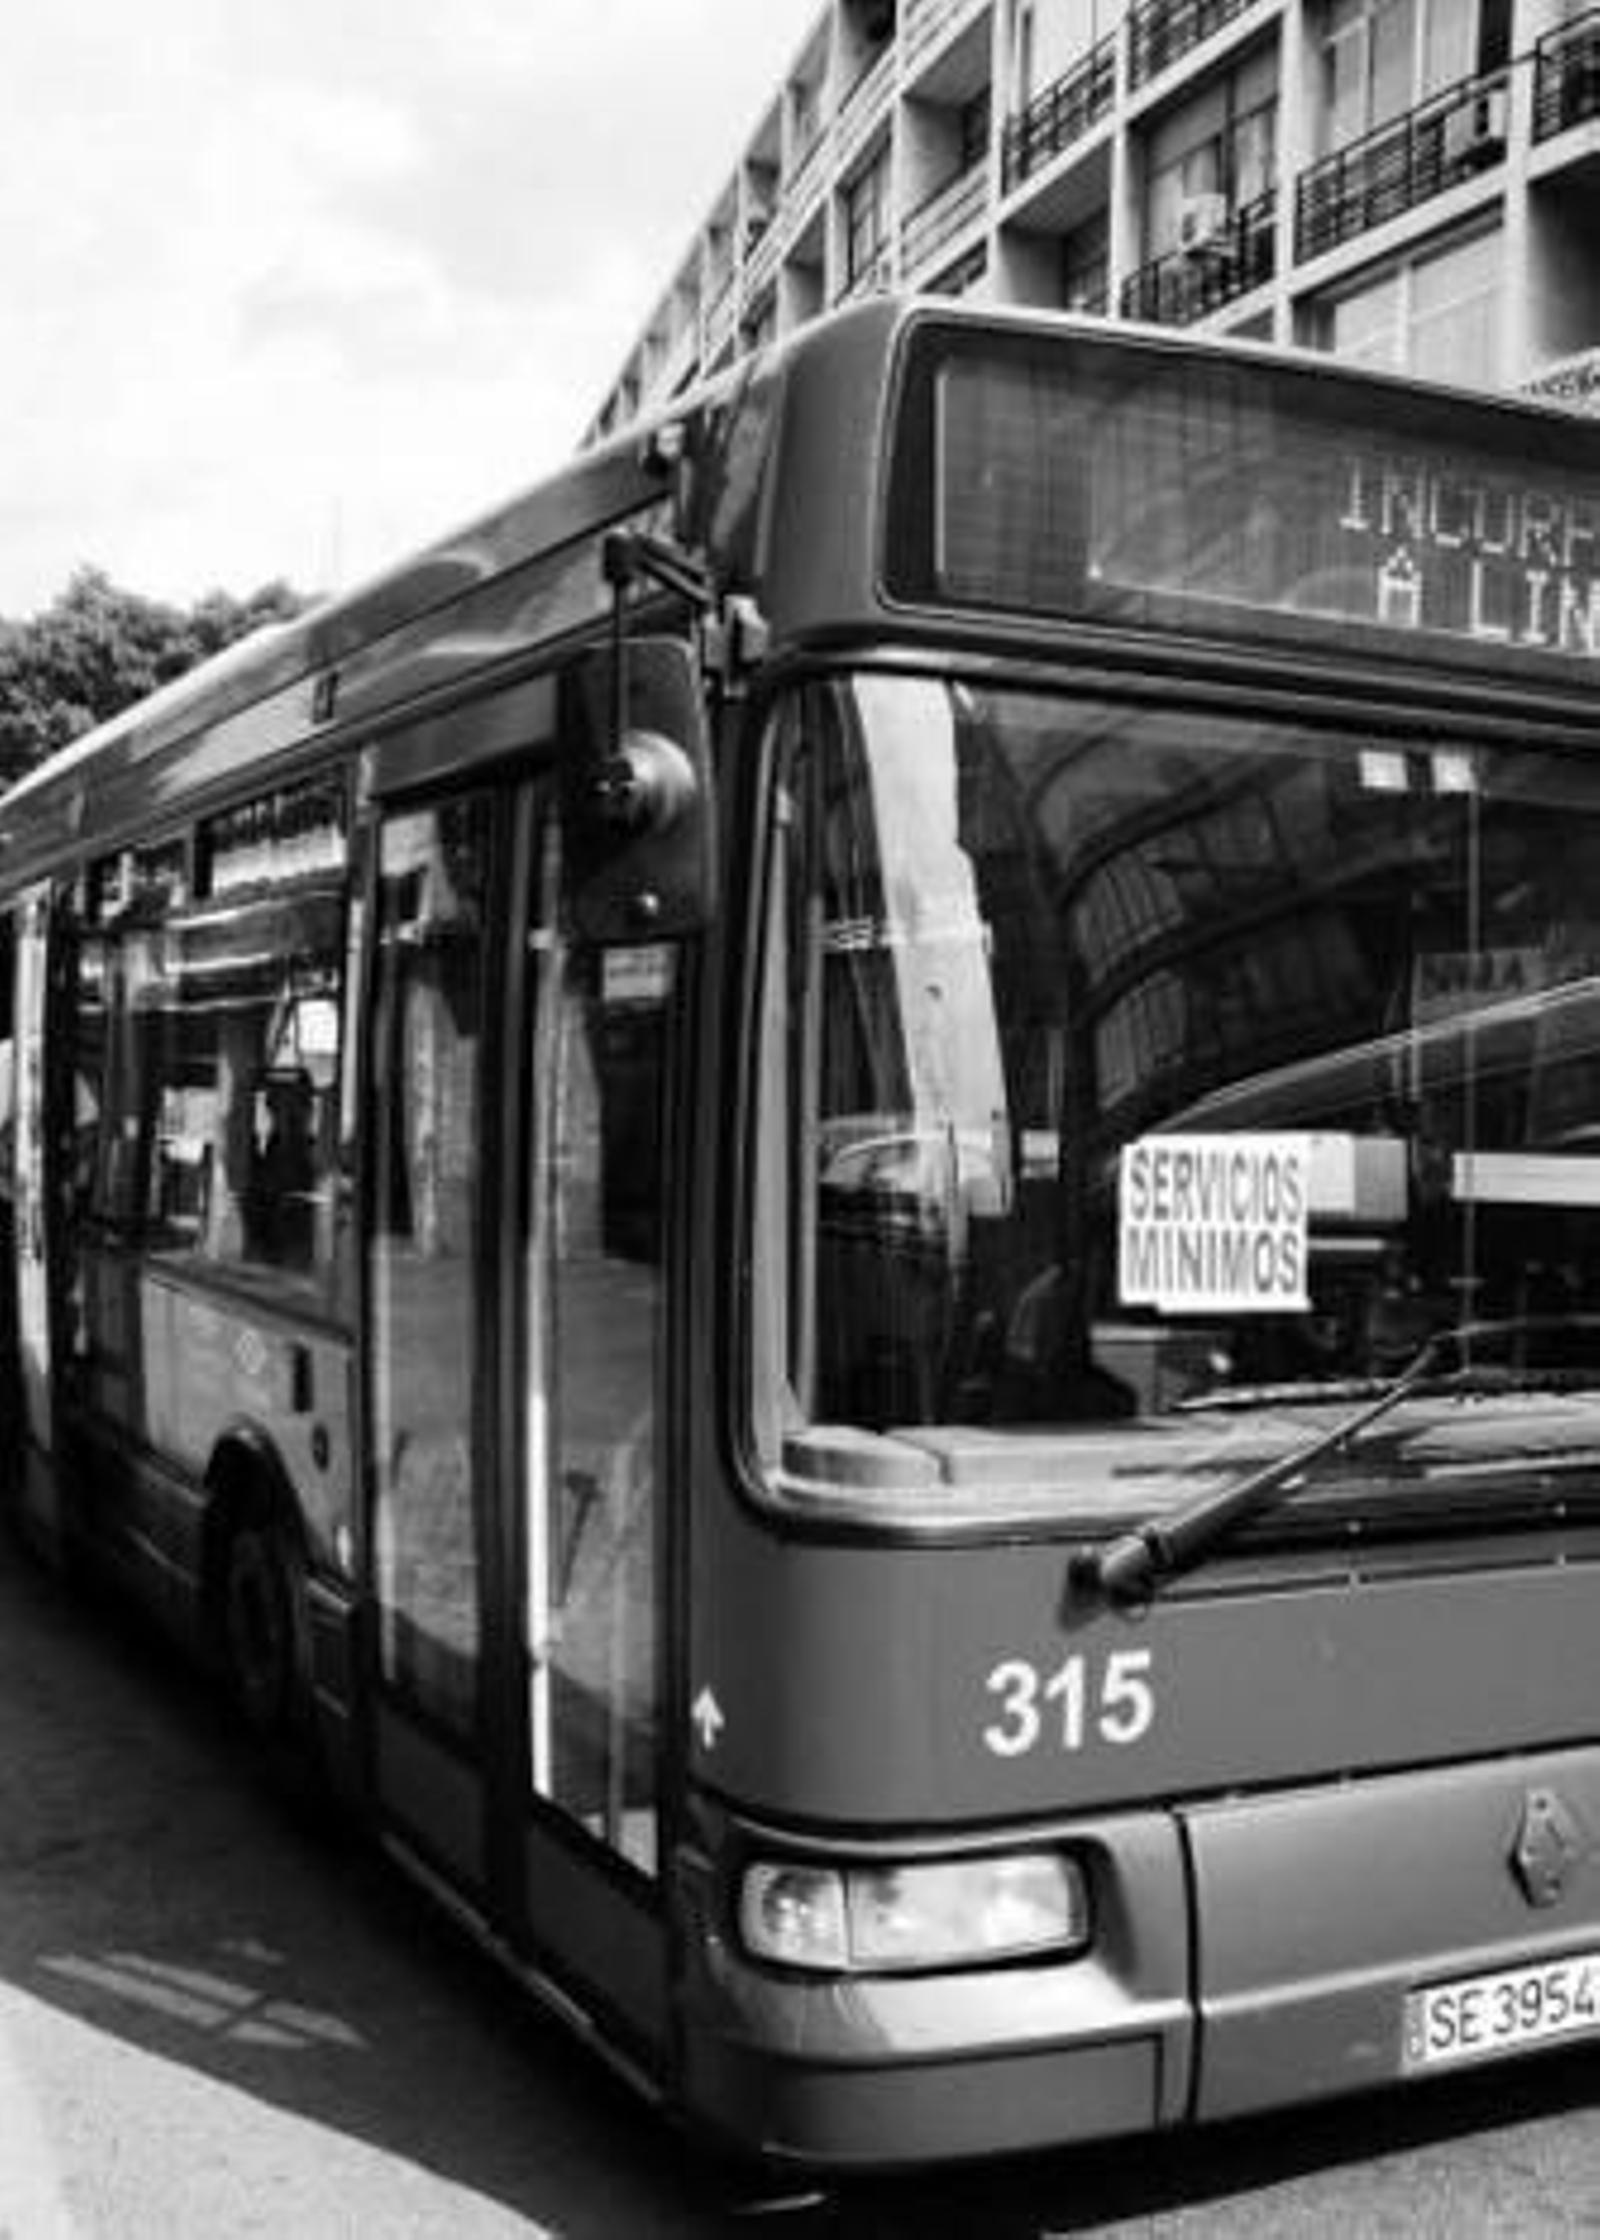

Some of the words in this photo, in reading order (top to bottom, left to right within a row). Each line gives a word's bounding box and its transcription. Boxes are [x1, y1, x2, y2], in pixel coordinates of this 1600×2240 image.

[1378, 546, 1422, 629] A
[1130, 1147, 1301, 1224] SERVICIOS
[1127, 1225, 1299, 1295] MINIMOS
[984, 1649, 1156, 1758] 315
[1430, 1988, 1484, 2048] SE
